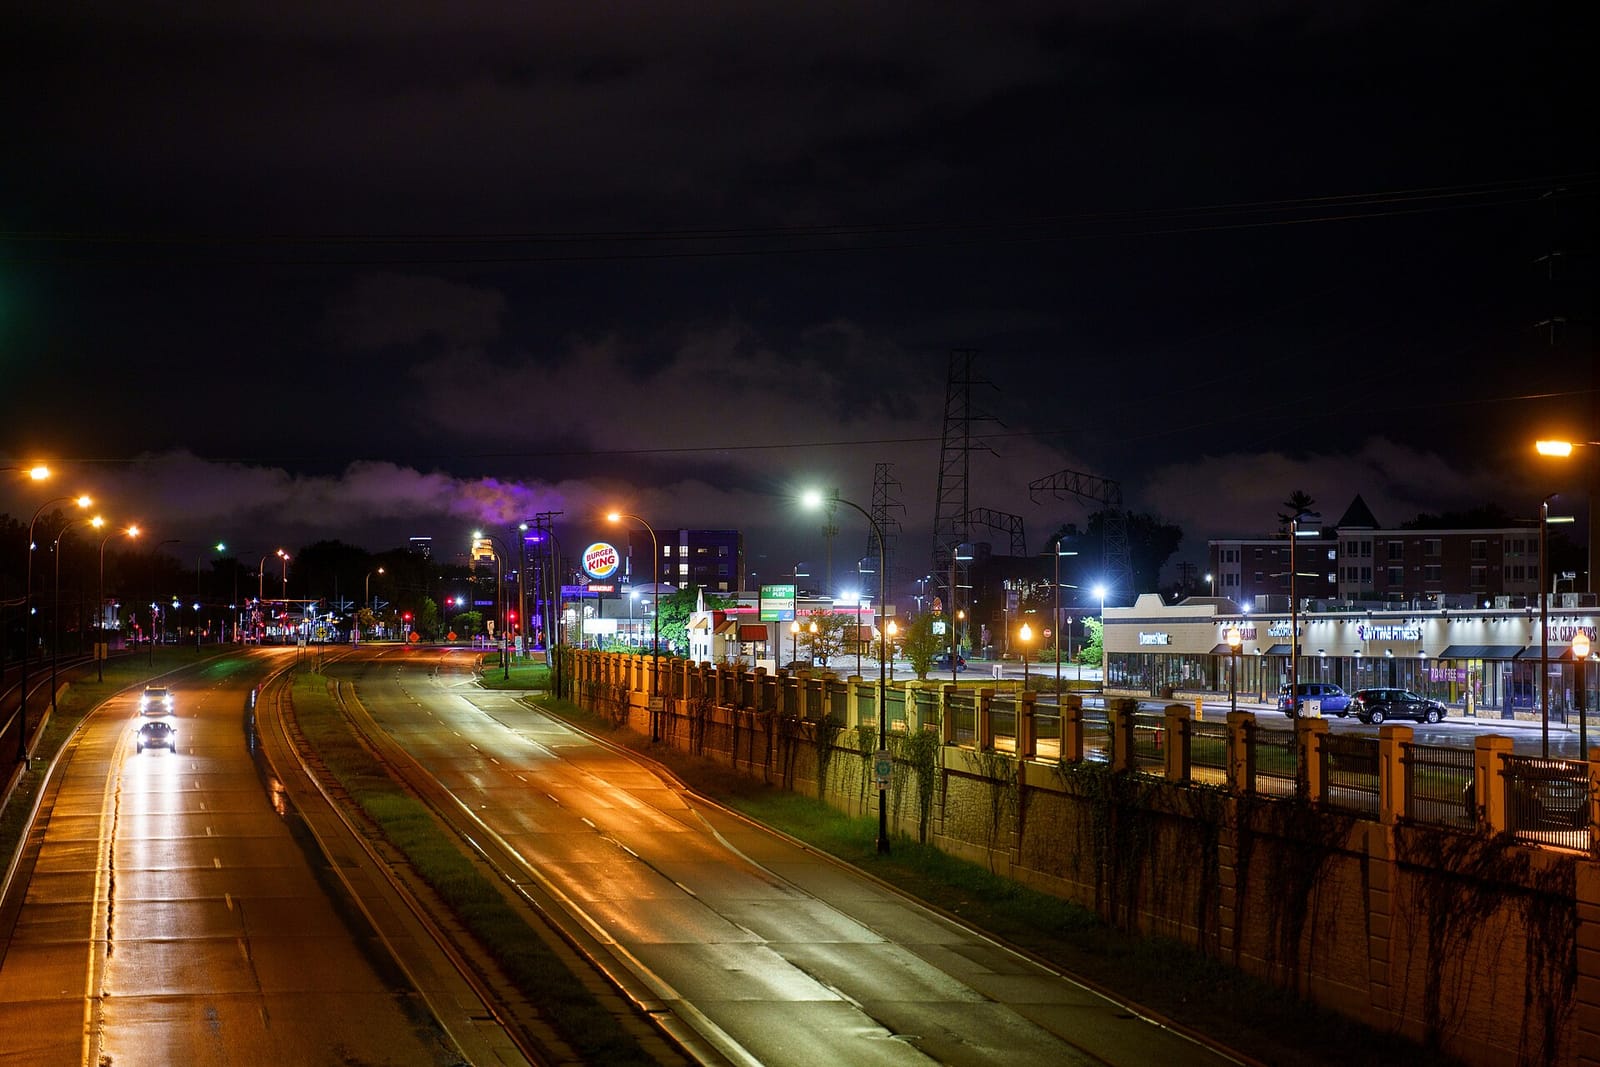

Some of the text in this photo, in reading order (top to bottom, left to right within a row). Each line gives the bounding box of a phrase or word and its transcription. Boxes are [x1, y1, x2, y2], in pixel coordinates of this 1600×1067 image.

[586, 548, 614, 562] BURGER
[588, 555, 616, 571] KING
[1363, 625, 1419, 641] ANYTIME FITNESS
[1444, 668, 1457, 679] FREE
